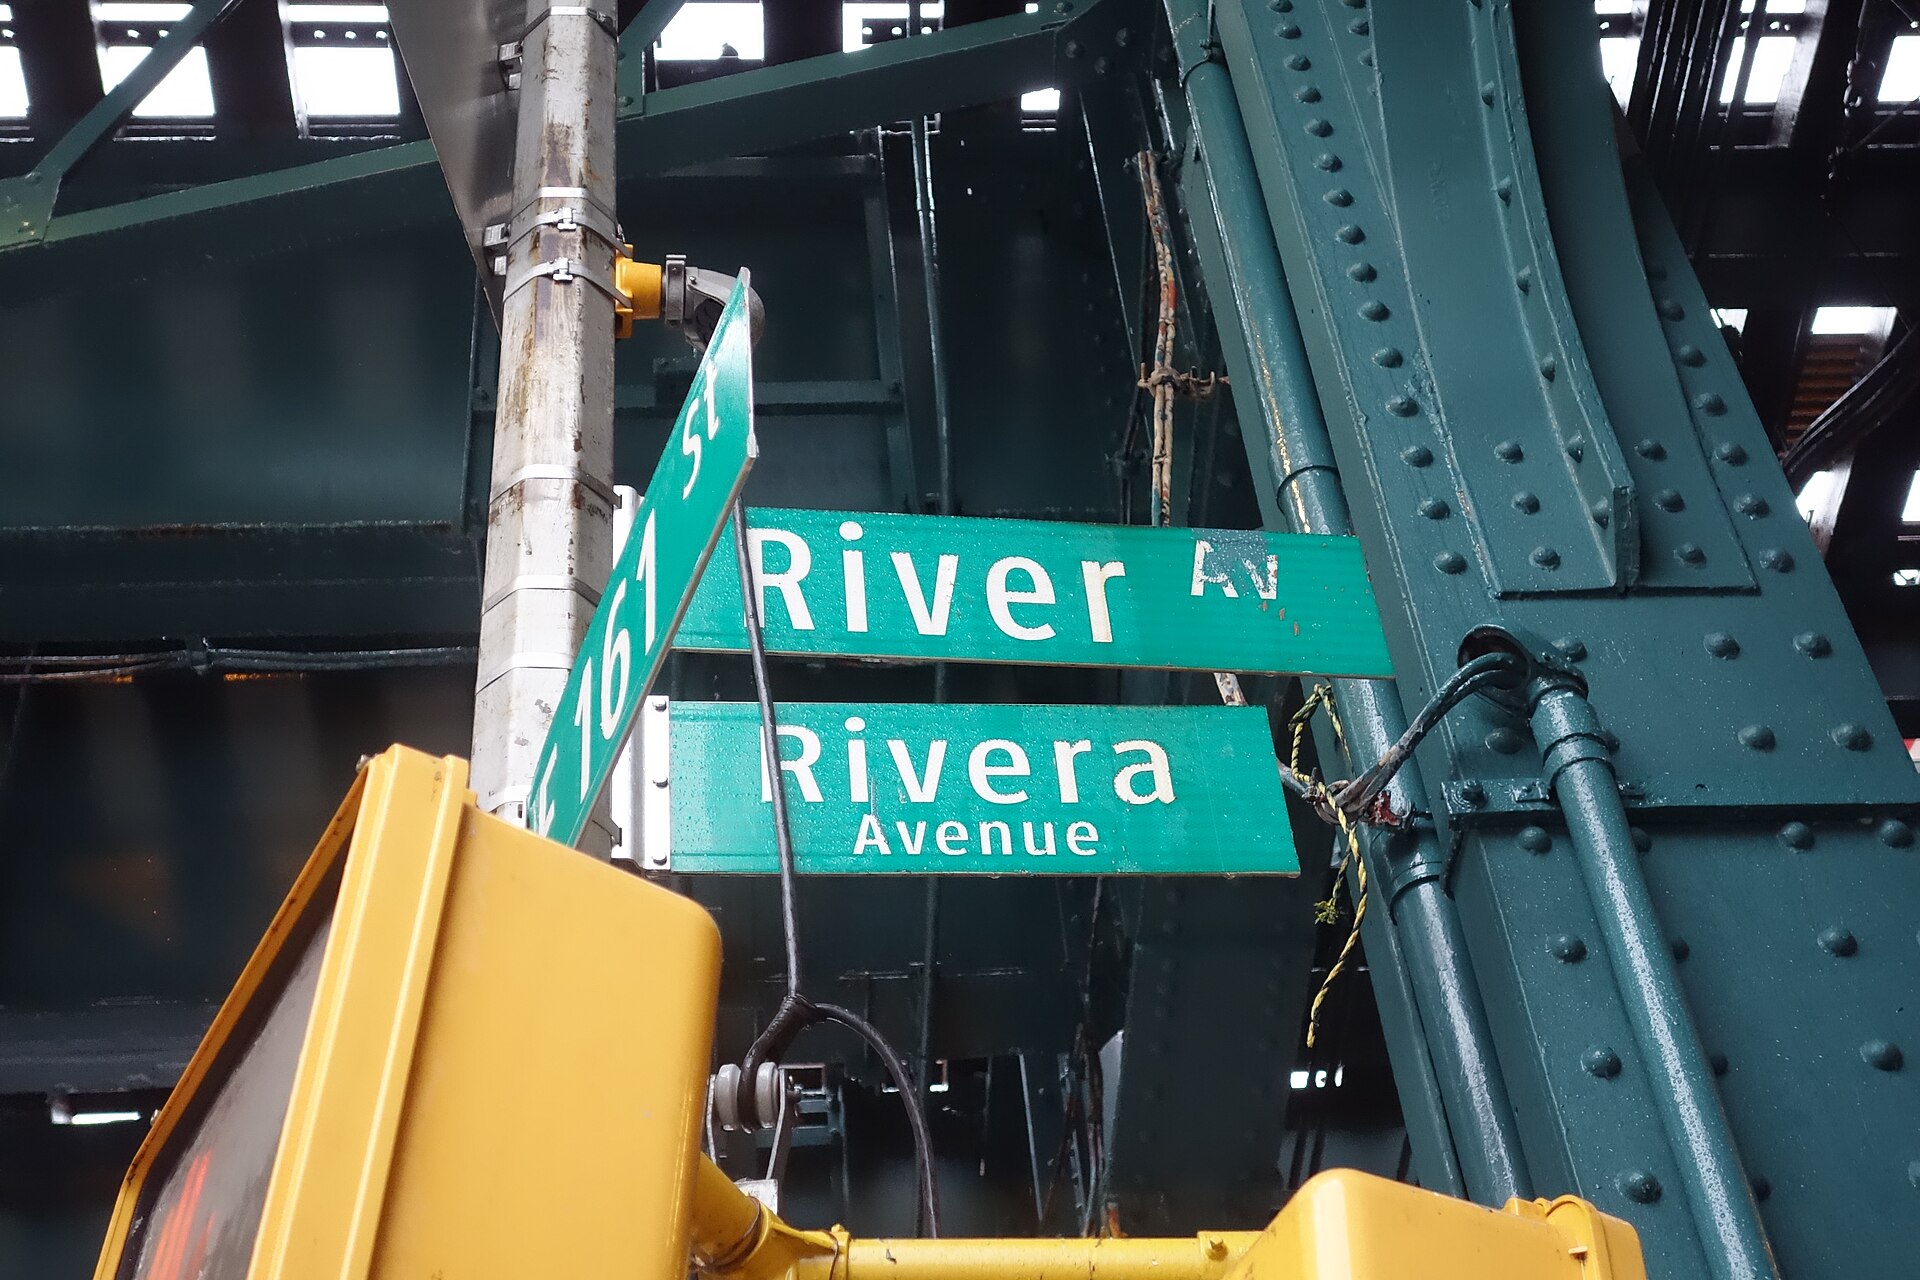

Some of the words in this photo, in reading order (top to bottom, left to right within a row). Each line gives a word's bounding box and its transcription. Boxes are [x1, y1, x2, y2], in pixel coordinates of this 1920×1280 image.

[573, 507, 657, 805] 161
[682, 359, 719, 501] St
[743, 520, 1126, 643] River
[759, 716, 1176, 805] Rivera
[852, 813, 1100, 856] Avenue
